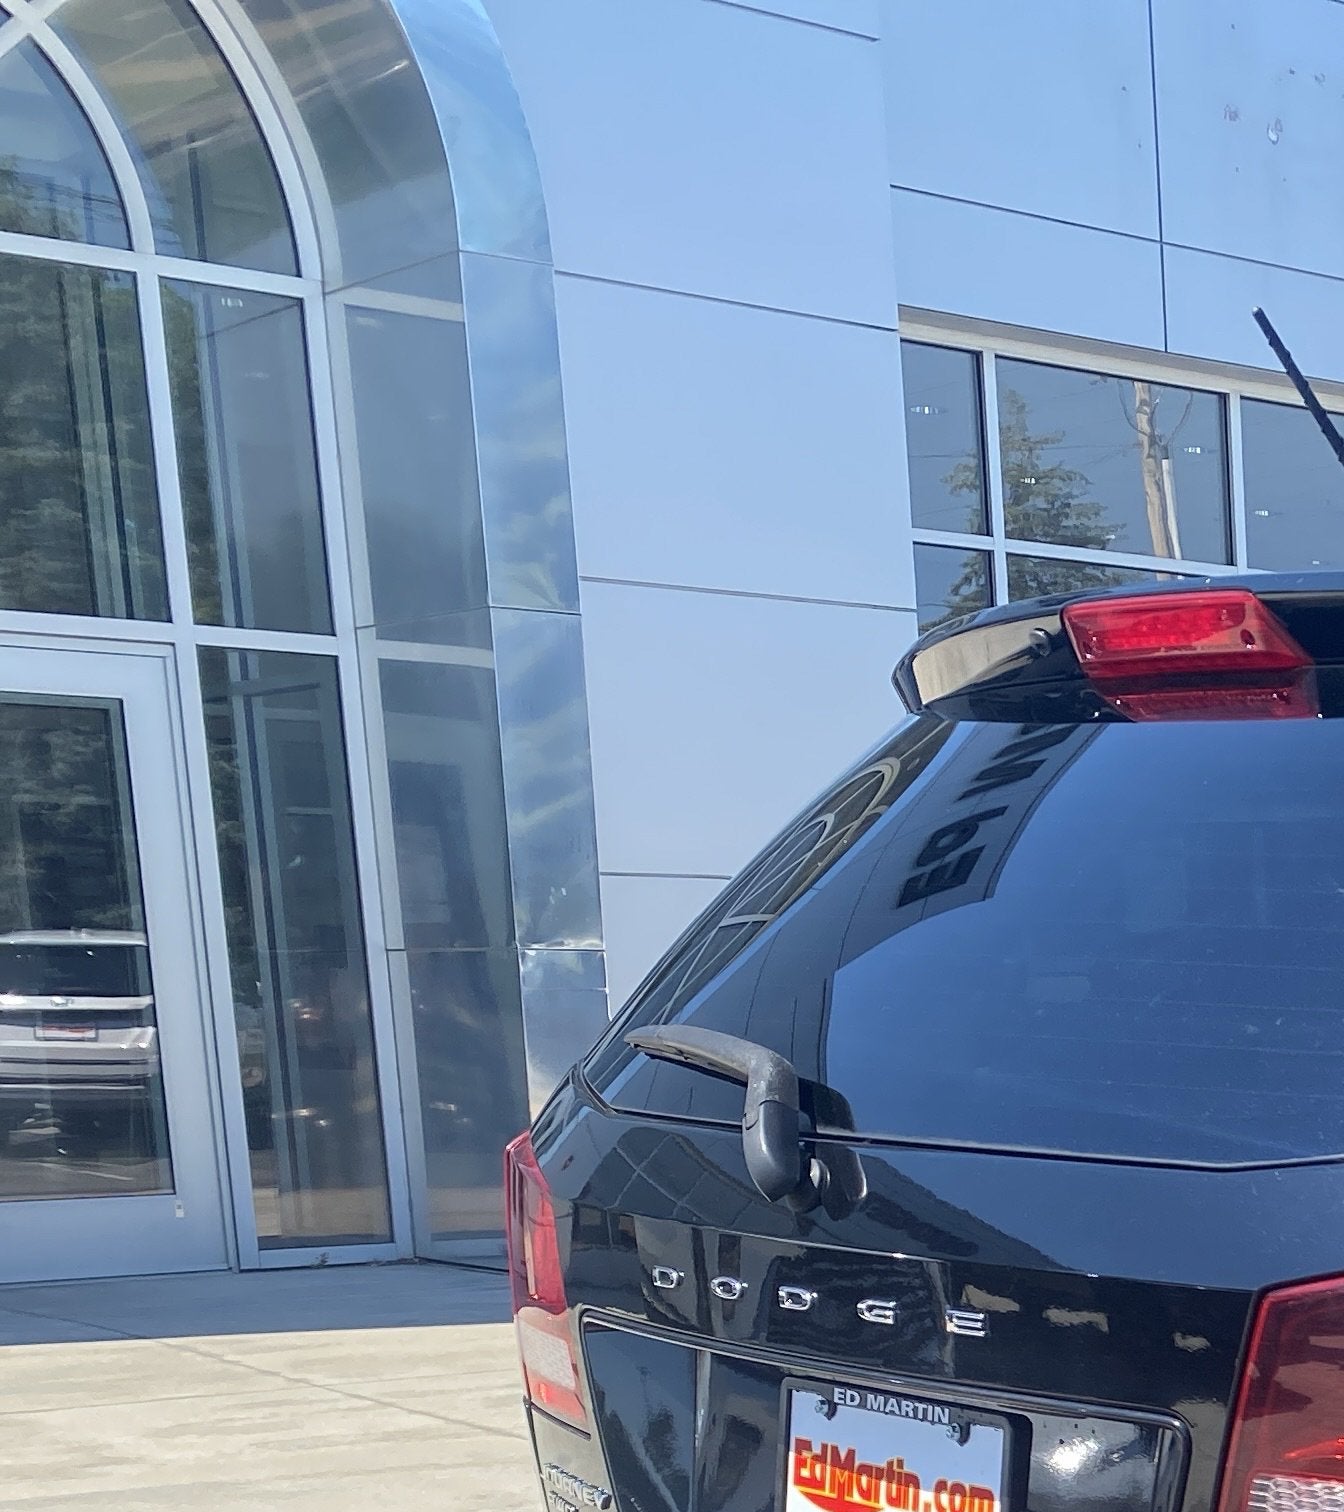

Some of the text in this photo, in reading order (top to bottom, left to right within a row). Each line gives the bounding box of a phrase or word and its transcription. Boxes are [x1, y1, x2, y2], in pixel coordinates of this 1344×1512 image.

[652, 1265, 988, 1336] DODGE
[833, 1388, 949, 1424] ED MARTIN
